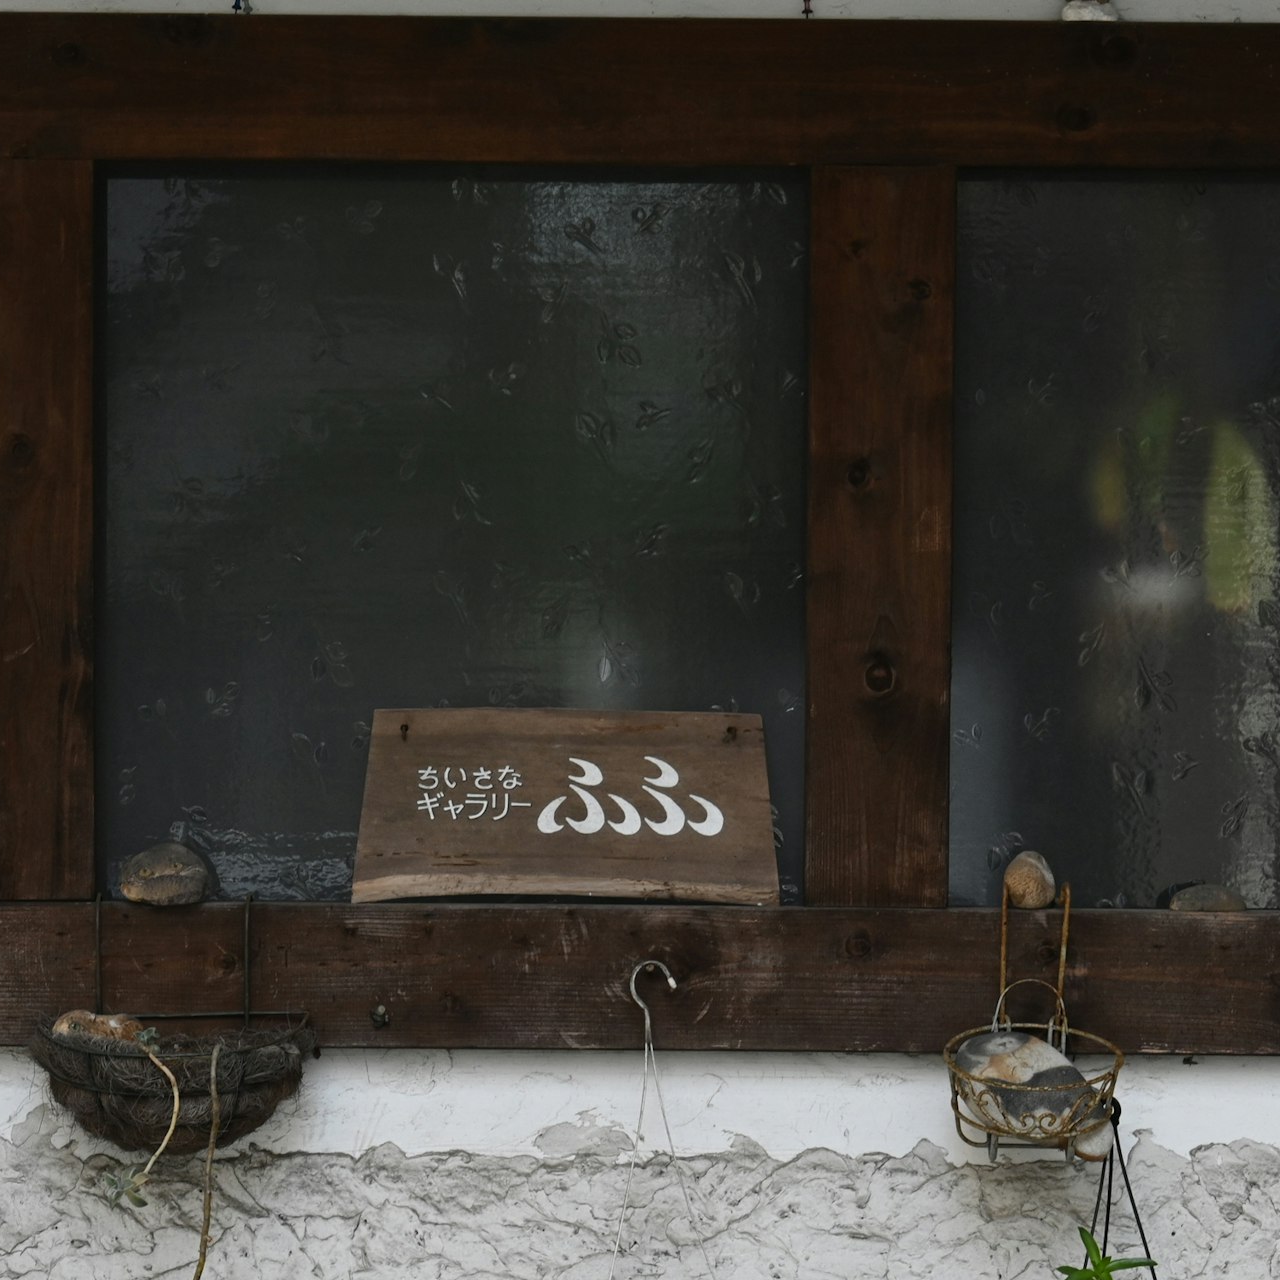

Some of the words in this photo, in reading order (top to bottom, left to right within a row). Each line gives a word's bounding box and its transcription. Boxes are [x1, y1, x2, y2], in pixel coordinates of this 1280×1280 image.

[417, 765, 523, 790] ちいさな
[416, 791, 532, 821] ギャラリー
